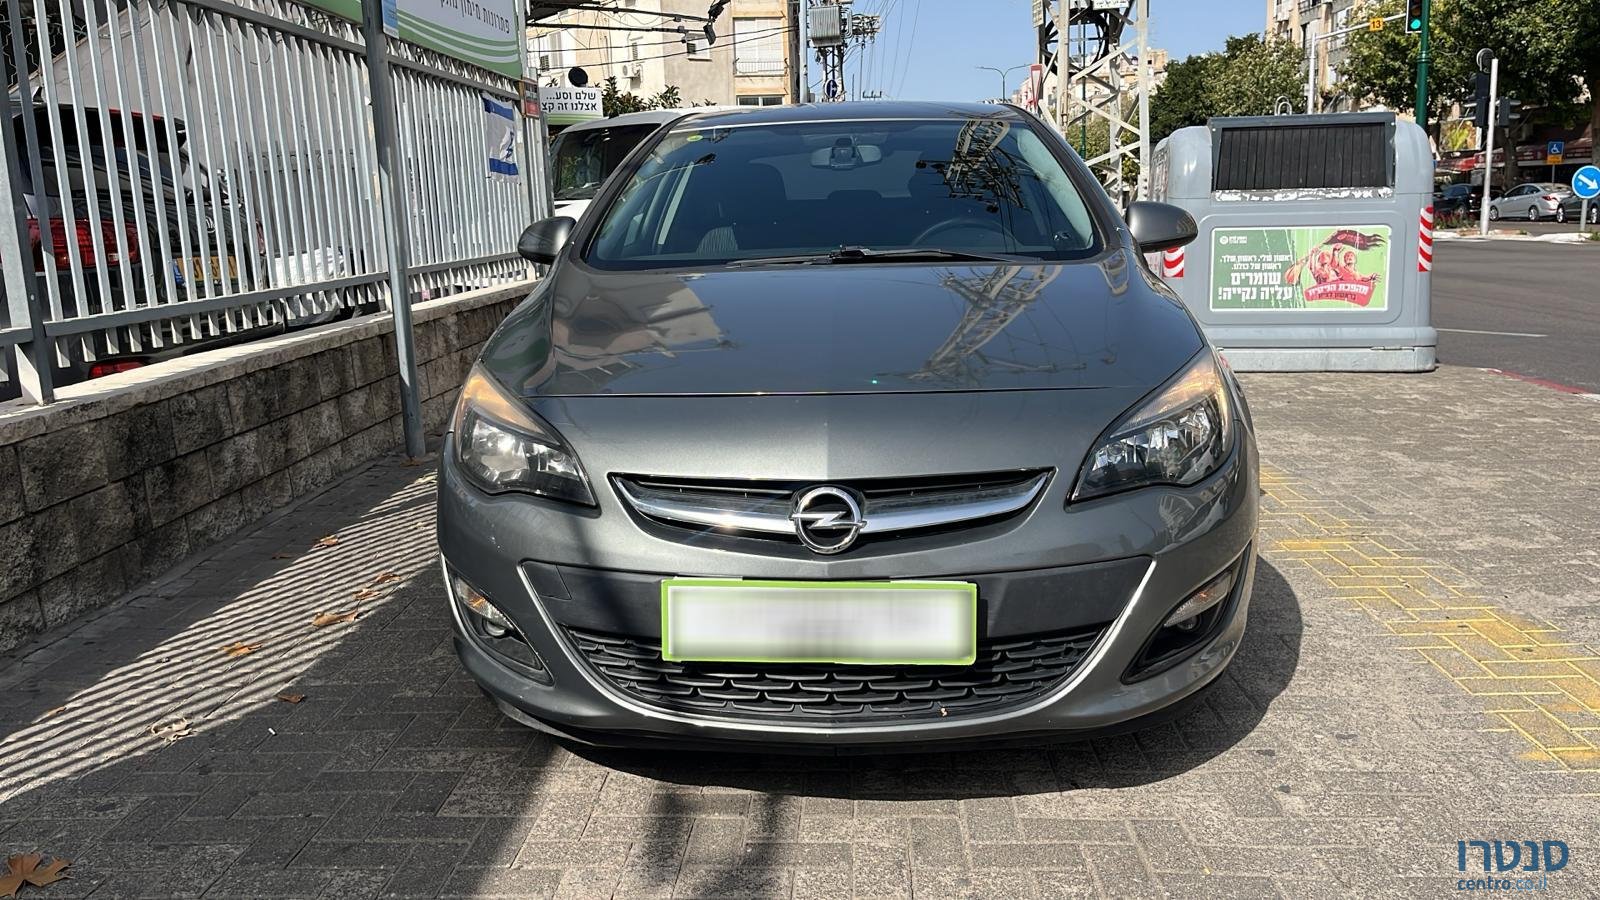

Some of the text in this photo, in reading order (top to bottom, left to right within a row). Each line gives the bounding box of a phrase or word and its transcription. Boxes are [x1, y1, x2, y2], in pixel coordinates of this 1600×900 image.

[460, 0, 481, 21] מימון
[482, 7, 510, 34] פתרונות
[1372, 20, 1381, 29] 13
[546, 90, 596, 100] שלם וסע...
[557, 102, 568, 111] זה
[571, 101, 597, 111] אצלנו
[1230, 271, 1282, 285] שומרים
[1218, 285, 1293, 302] עליה נקייה!
